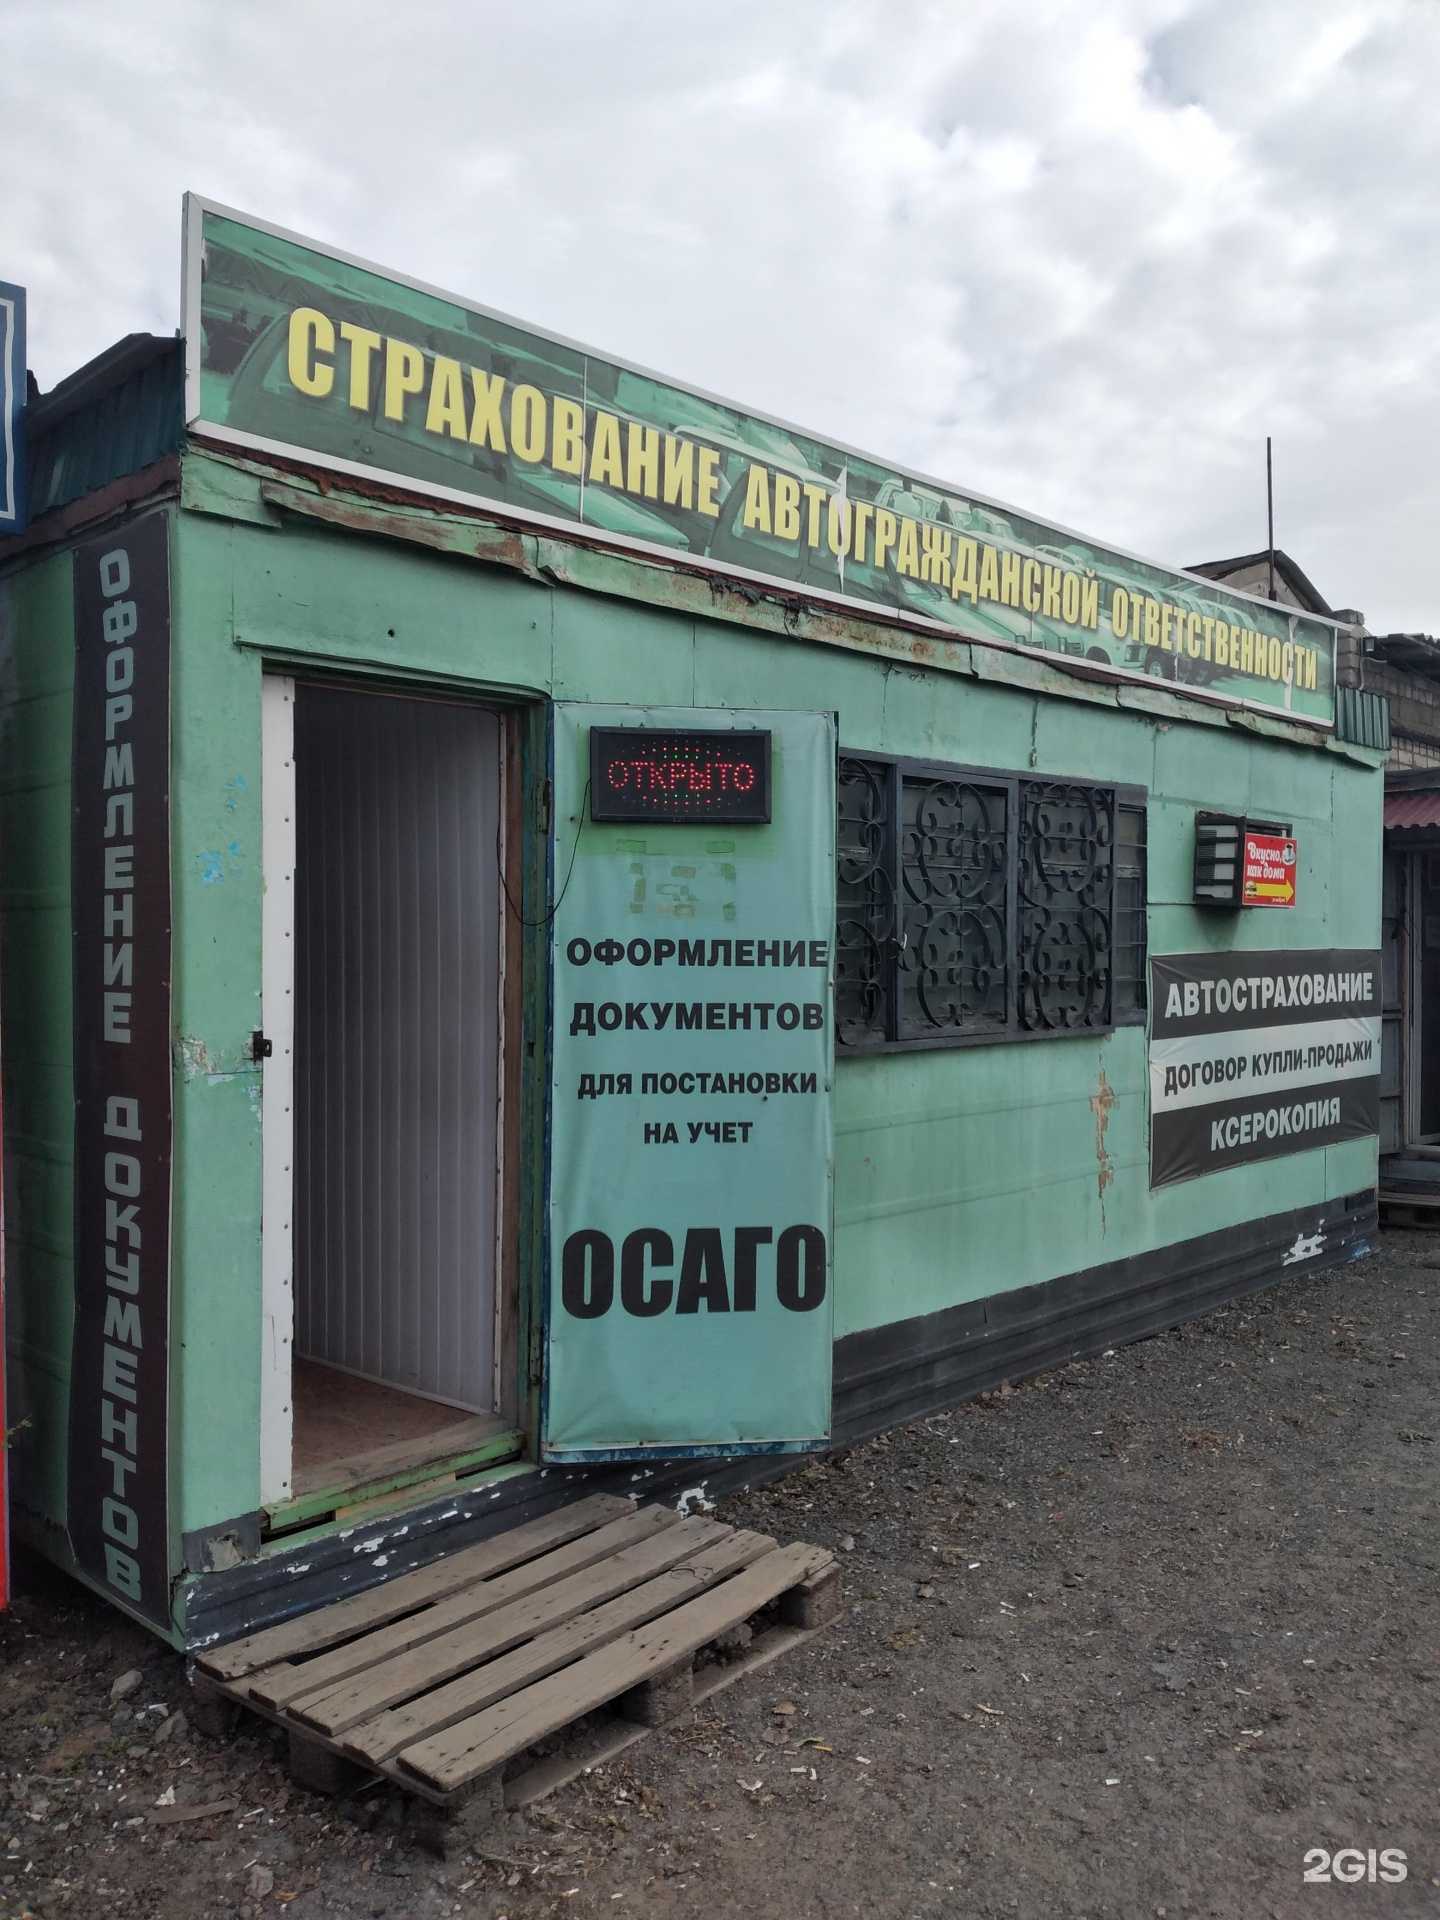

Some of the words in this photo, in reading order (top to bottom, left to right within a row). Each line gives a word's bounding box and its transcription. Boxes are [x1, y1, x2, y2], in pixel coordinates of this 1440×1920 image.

[288, 307, 721, 517] СТРАХОВАНИЕ
[743, 463, 1099, 630] АВТОГРАЖДАНСКОЙ
[1111, 594, 1318, 690] ОТВЕТСТВЕННОСТИ
[99, 548, 138, 1044] ОФОРМЛЕНИЕ
[608, 760, 755, 791] ОТКРЫТО
[1263, 863, 1285, 880] дома
[566, 937, 828, 968] ОФОРМЛЕНИЕ
[569, 1002, 824, 1036] ДОКУМЕНТОВ
[1165, 972, 1374, 1019] АВТОСТРАХОВАНИЕ
[578, 1073, 632, 1100] ДЛЯ
[641, 1072, 818, 1094] ПОСТАНОВКИ
[1164, 1055, 1247, 1096] ДОГОВОР
[1252, 1039, 1373, 1078] КУПЛИ-ПРОДАЖИ
[644, 1122, 679, 1144] НА
[687, 1121, 753, 1143] УЧЕТ
[1211, 1097, 1341, 1151] КСЕРОКОПИЯ
[562, 1224, 827, 1319] ОСАГО
[102, 1095, 142, 1602] ДОКУМЕНТОВ
